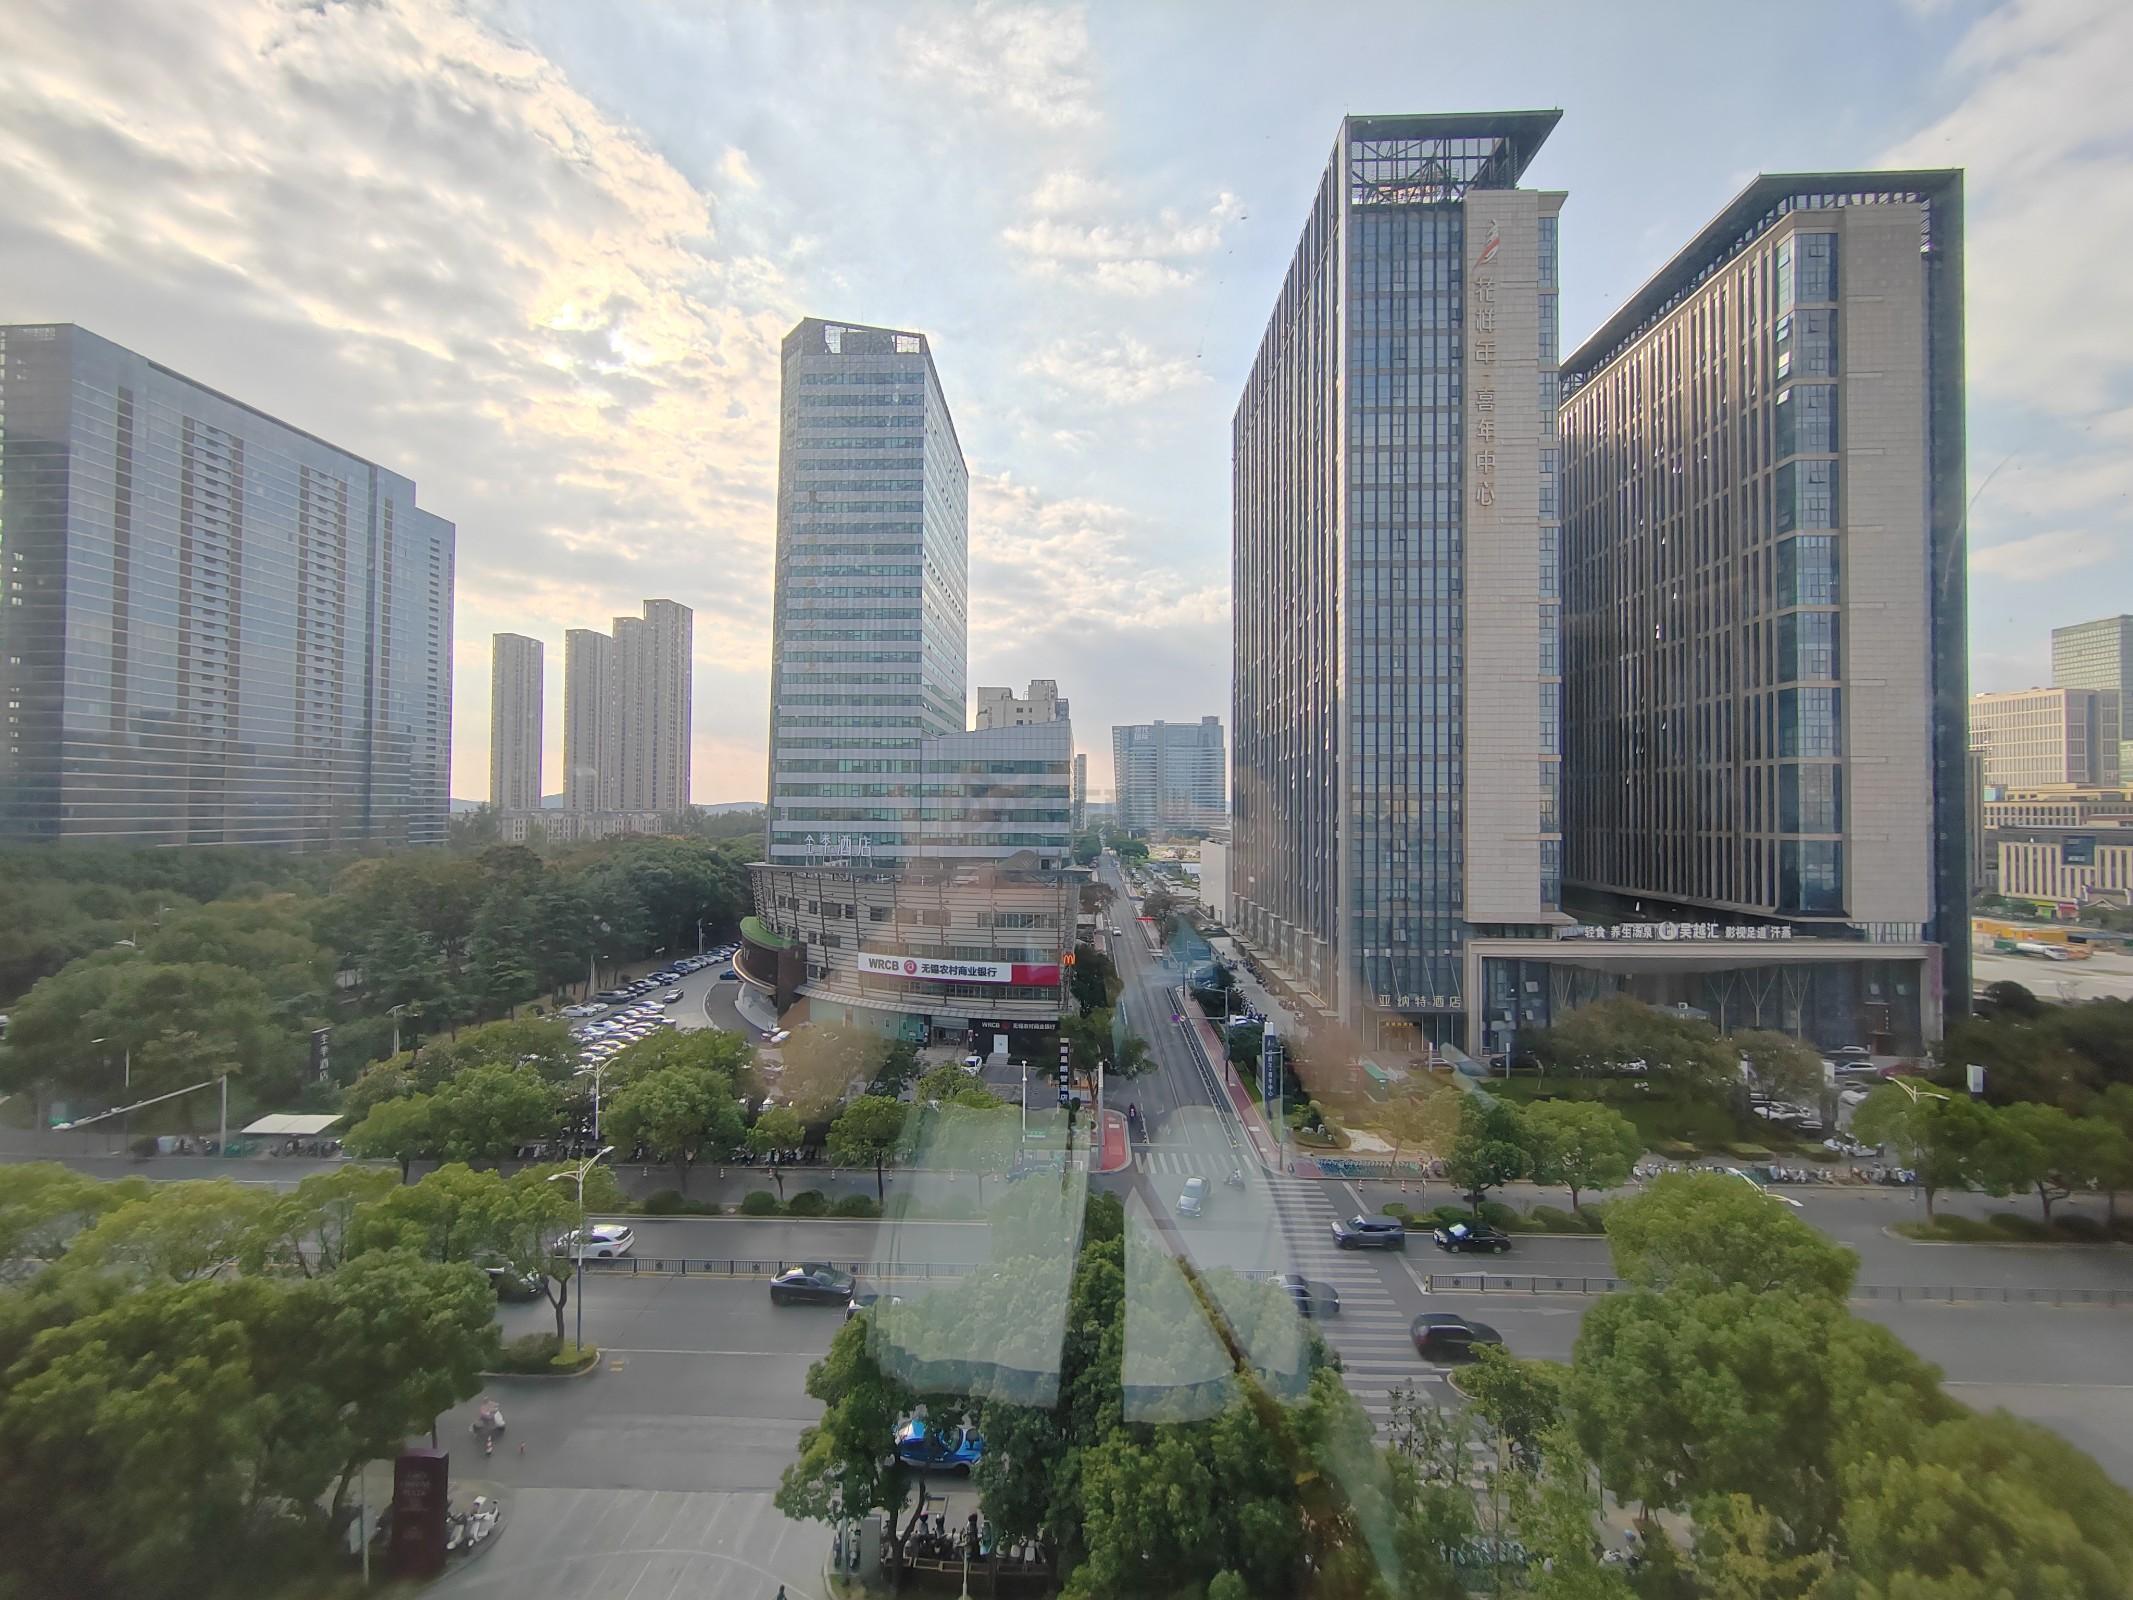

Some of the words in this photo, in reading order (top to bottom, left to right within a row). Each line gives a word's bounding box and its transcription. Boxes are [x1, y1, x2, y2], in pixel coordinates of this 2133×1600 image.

[804, 834, 871, 857] 全季酒店
[1680, 922, 1719, 939] 吴越汇
[868, 958, 899, 971] WRCB
[921, 963, 998, 978] 无锡农村商业银行
[1378, 994, 1462, 1008] 亚纳特酒店
